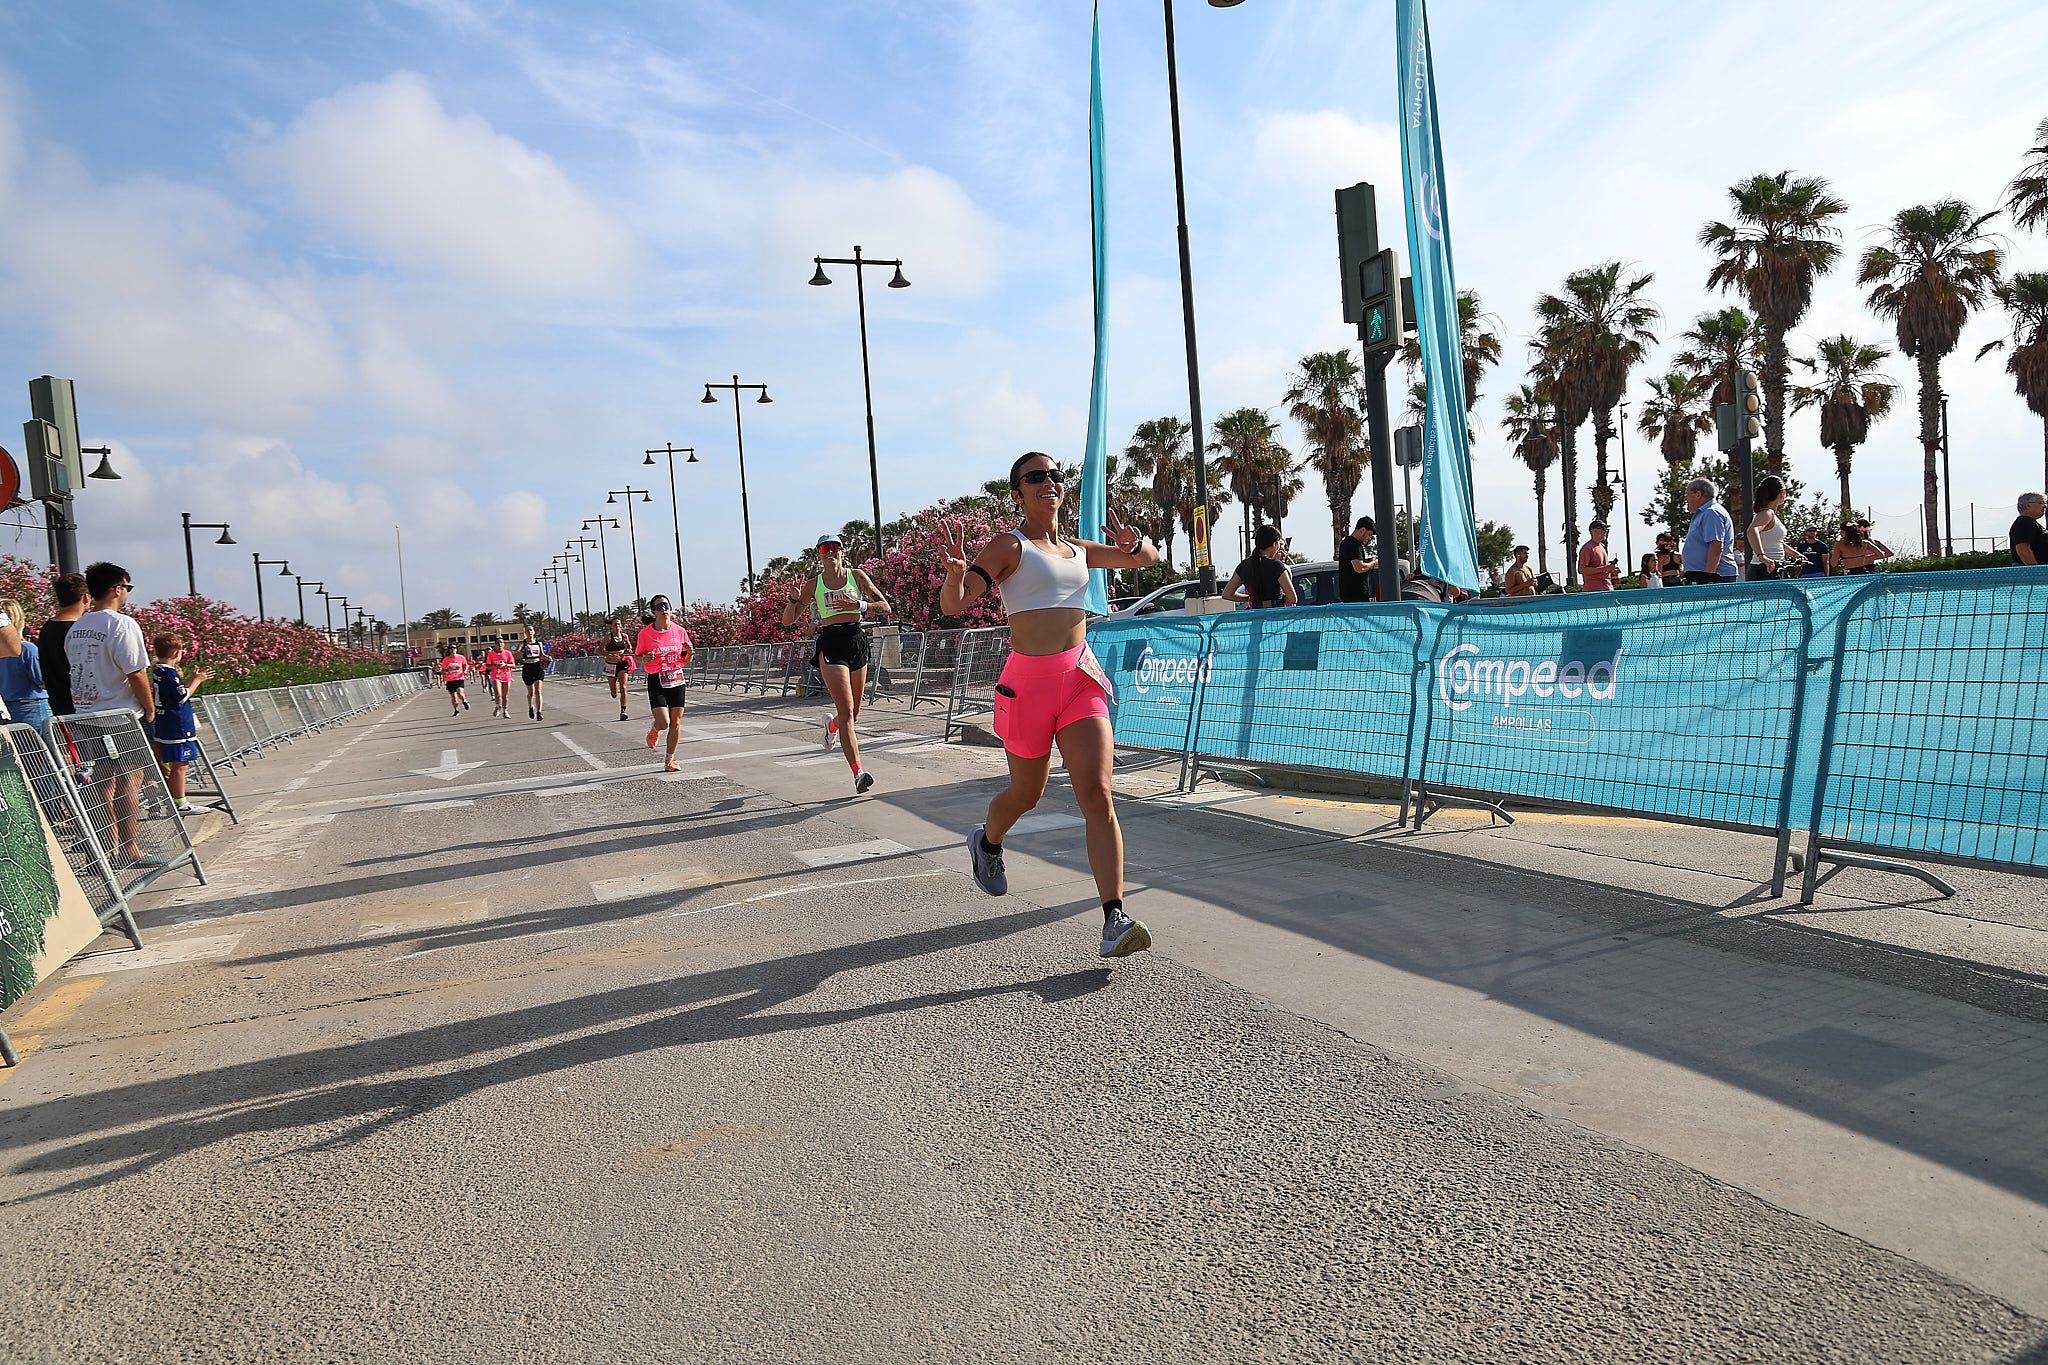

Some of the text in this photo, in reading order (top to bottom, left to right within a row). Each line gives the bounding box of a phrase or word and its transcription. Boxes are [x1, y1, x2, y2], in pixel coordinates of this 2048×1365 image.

[1135, 646, 1213, 694] Compeed
[1439, 643, 1618, 711] Compeed
[1492, 716, 1552, 733] AMPOLLAS
